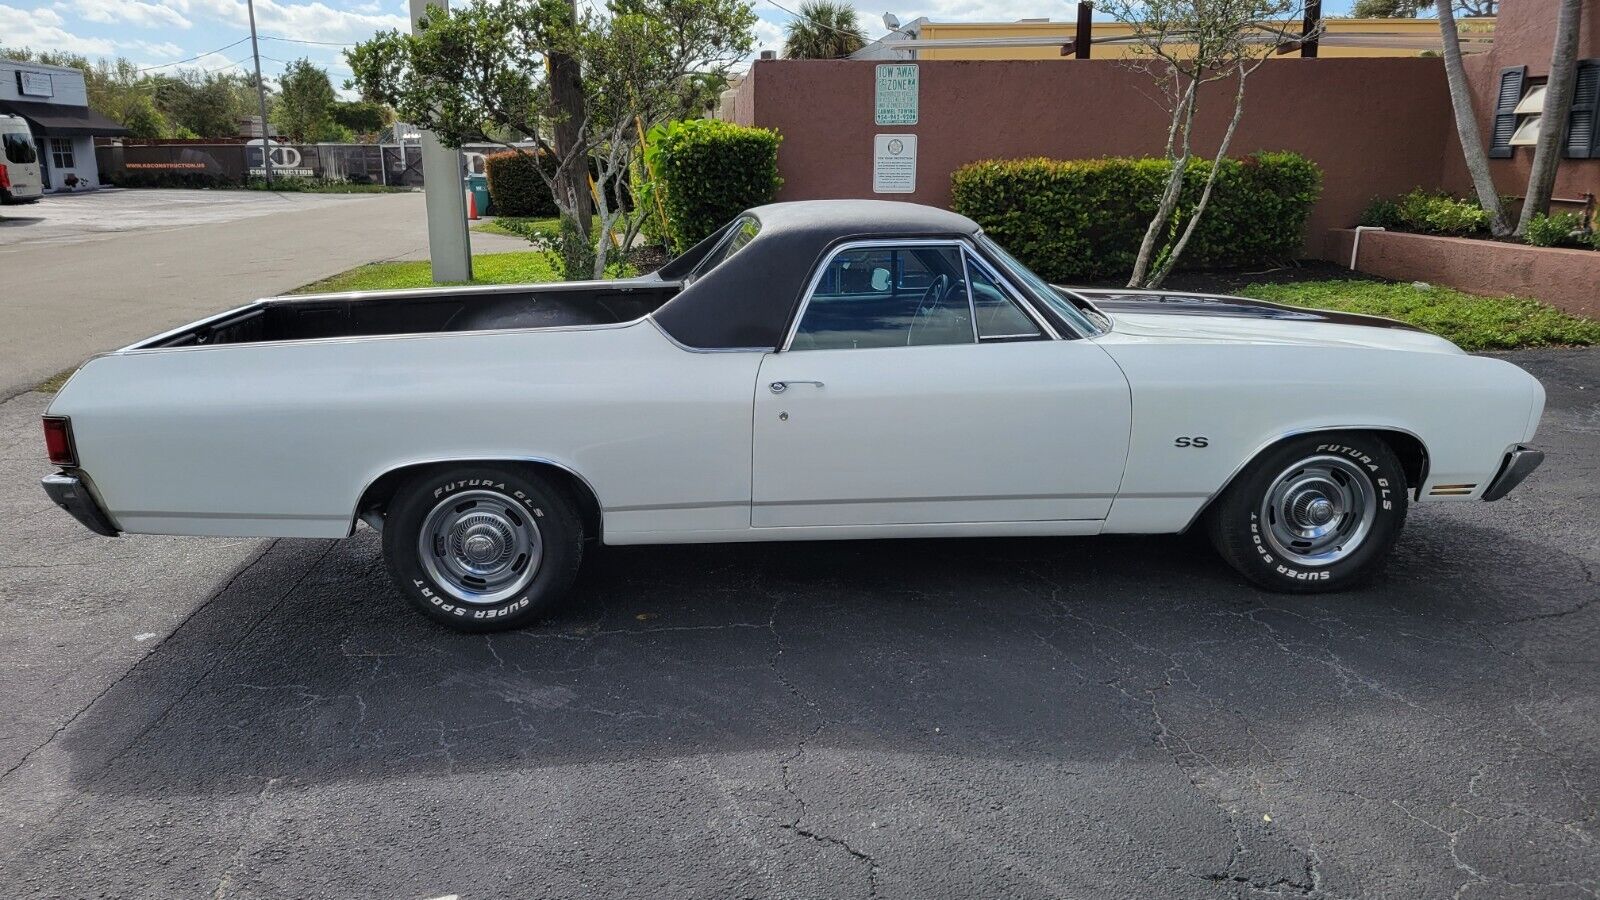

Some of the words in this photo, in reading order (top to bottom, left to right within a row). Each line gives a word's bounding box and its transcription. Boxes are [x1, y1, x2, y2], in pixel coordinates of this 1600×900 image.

[879, 66, 894, 78] TOW
[897, 66, 916, 78] AWAY
[888, 79, 907, 91] ZONE
[1174, 436, 1209, 448] SS
[1316, 444, 1379, 472] FUTURA
[1377, 477, 1392, 511] GLS
[434, 479, 505, 499] FUTURA
[513, 490, 545, 518] GLS
[1250, 512, 1274, 564] SPORT
[1276, 564, 1330, 581] SUPER
[412, 579, 467, 617] SPORT
[473, 596, 530, 619] SUPER
